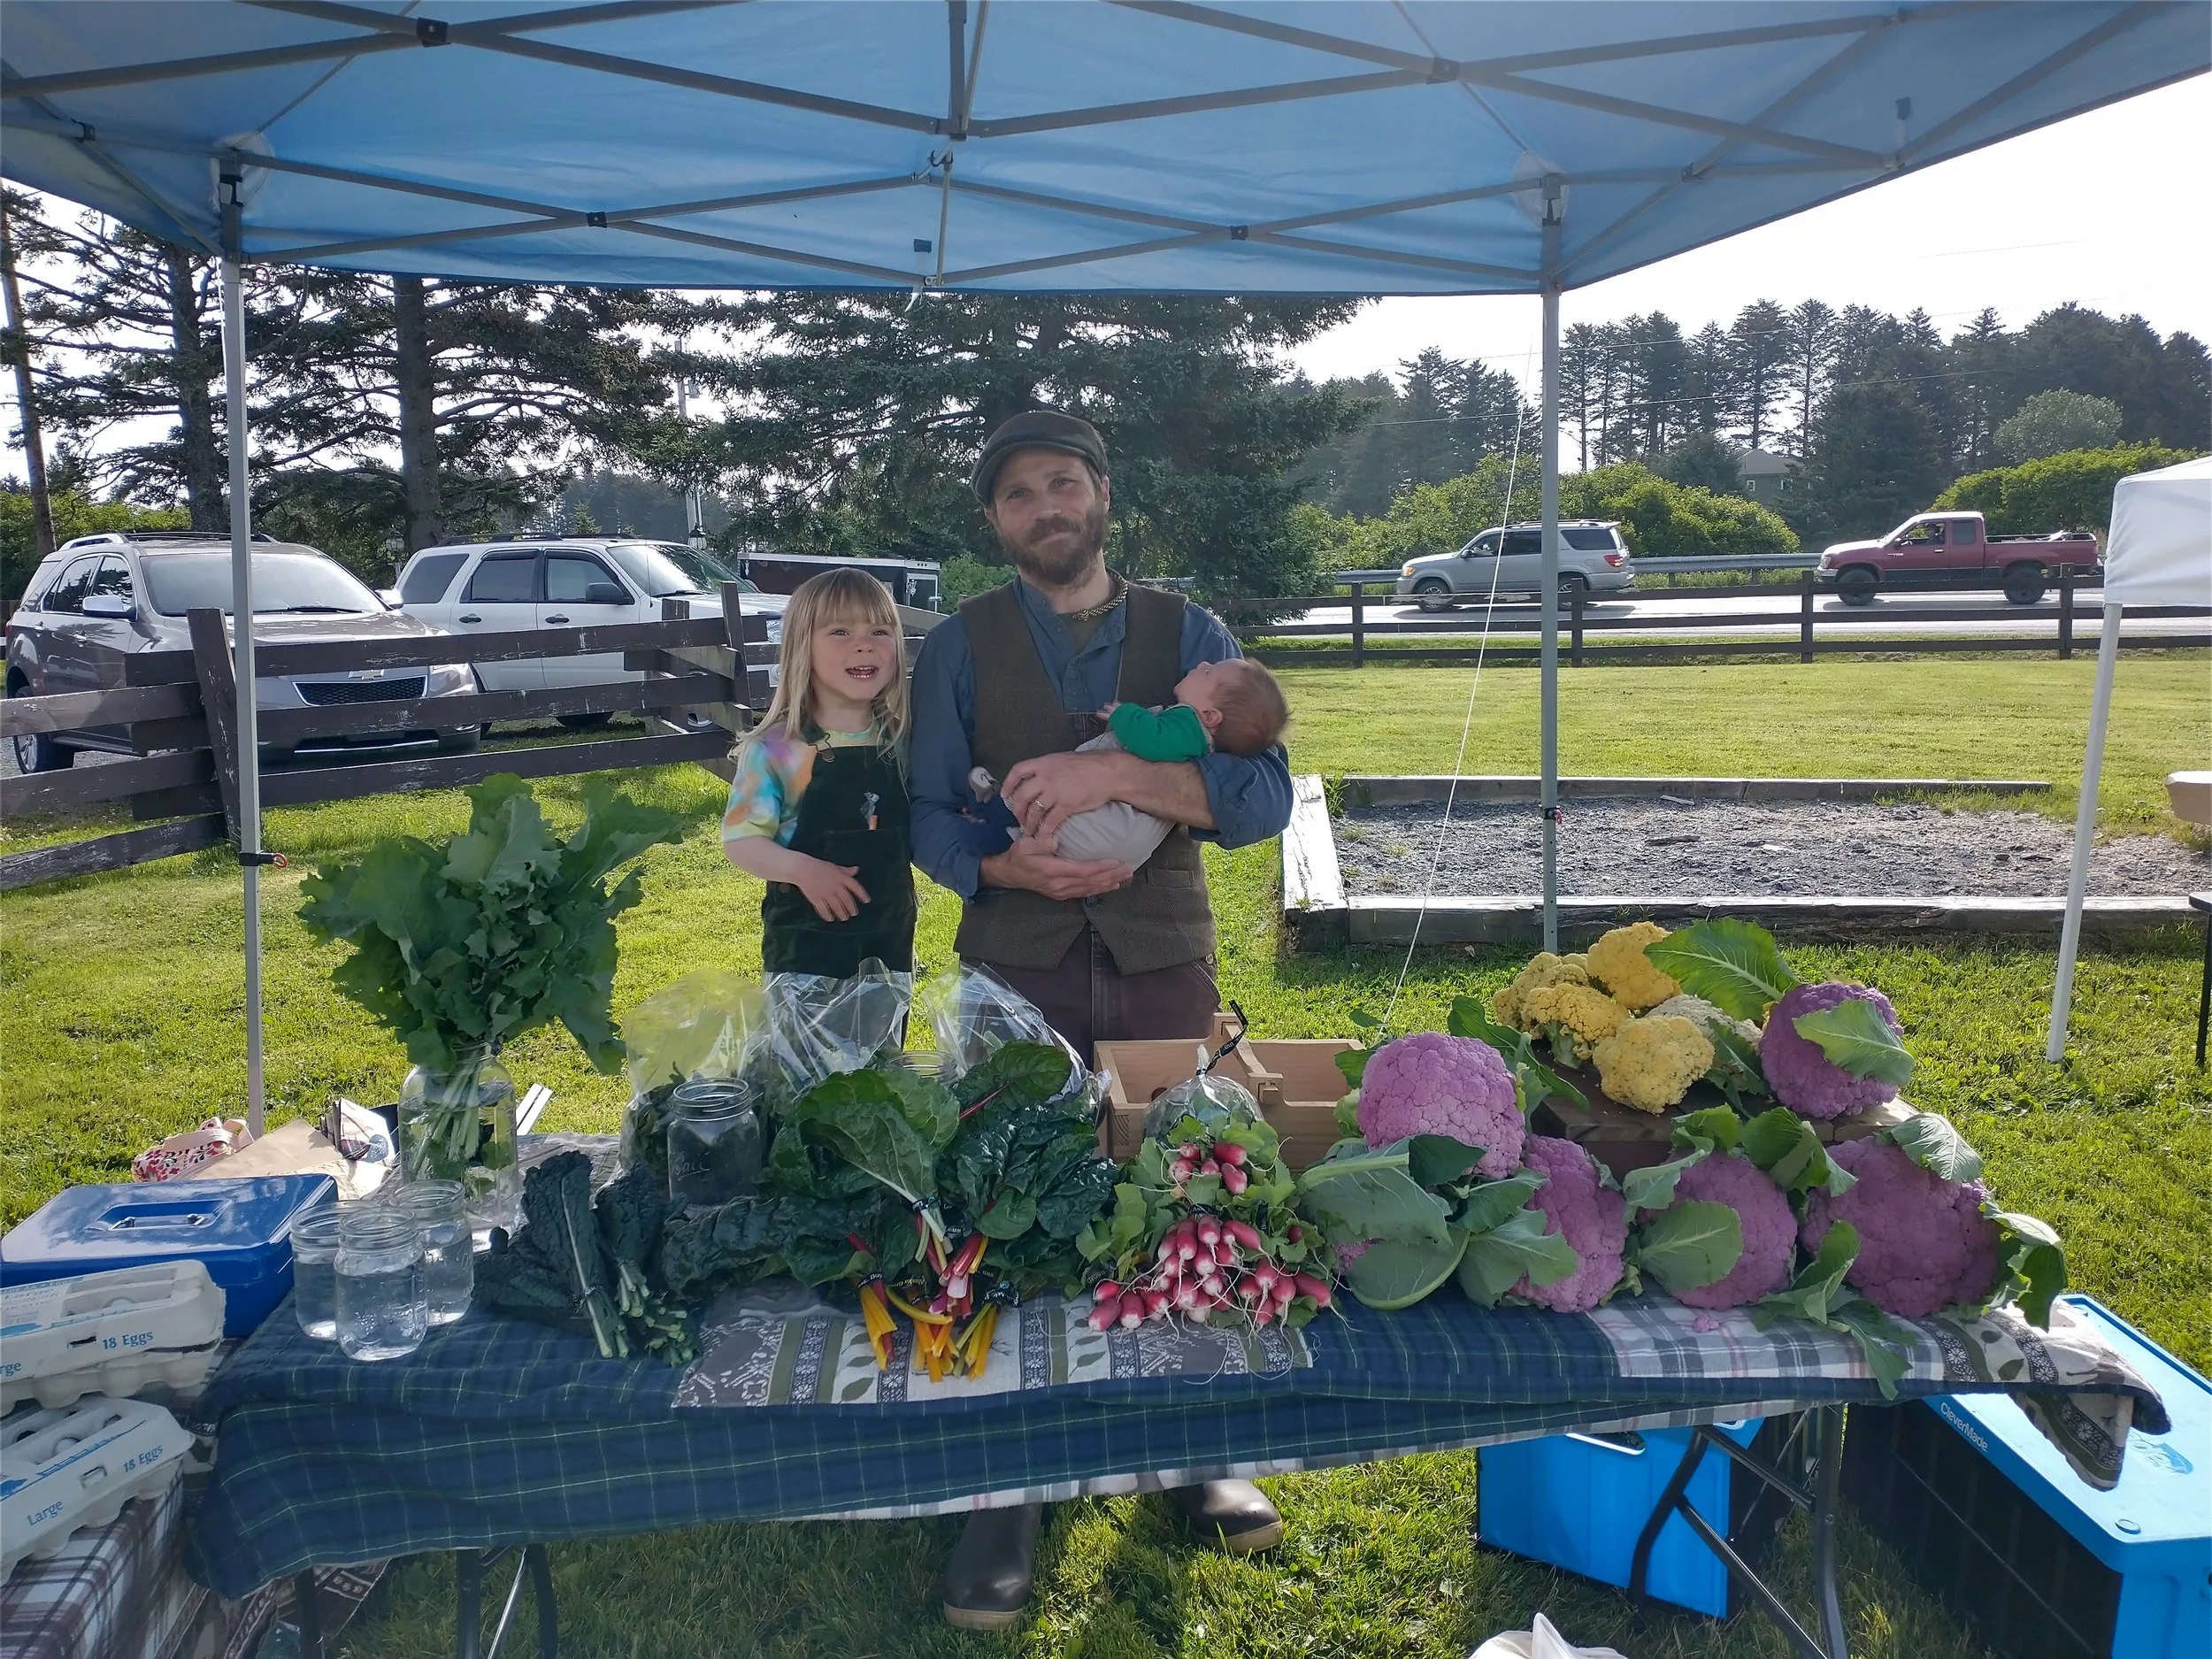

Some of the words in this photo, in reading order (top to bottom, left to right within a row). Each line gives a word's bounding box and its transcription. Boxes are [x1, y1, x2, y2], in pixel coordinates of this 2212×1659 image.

[102, 1337, 118, 1350] 18
[122, 1331, 154, 1348] Eggs
[1940, 1402, 1989, 1452] CleverMade
[122, 1458, 136, 1473] 18
[138, 1445, 164, 1465] Eggs
[27, 1500, 65, 1526] Large
